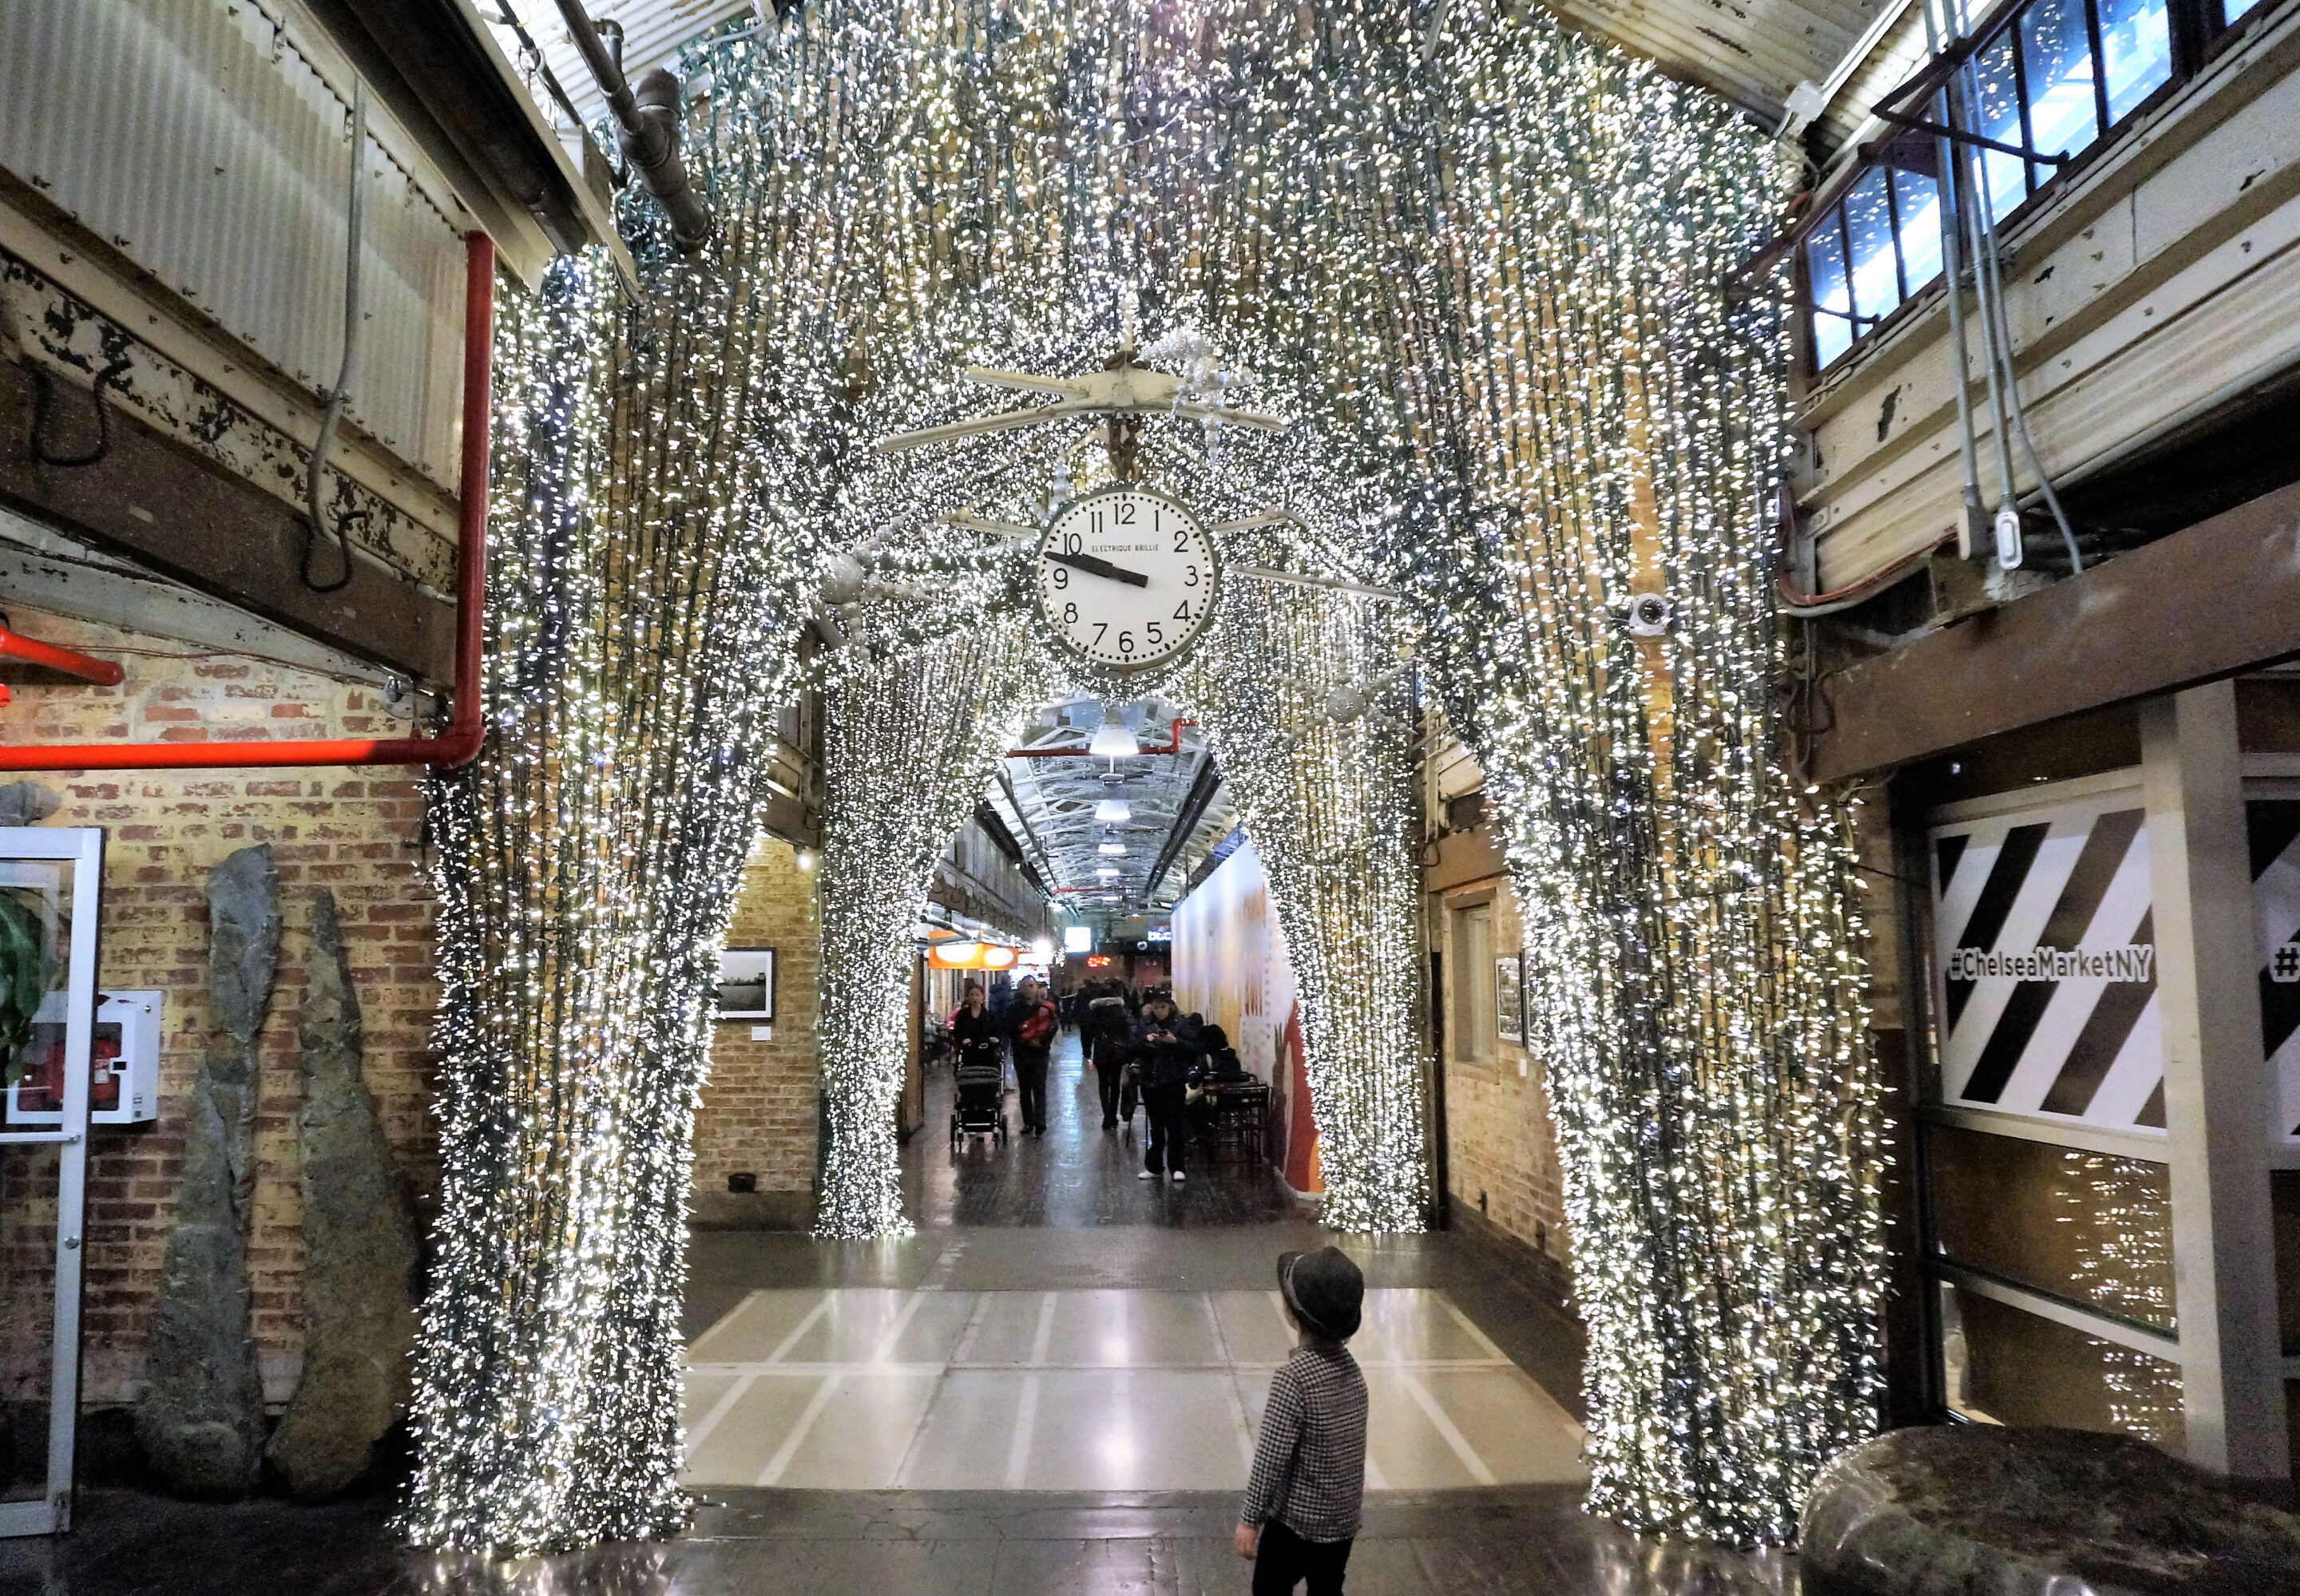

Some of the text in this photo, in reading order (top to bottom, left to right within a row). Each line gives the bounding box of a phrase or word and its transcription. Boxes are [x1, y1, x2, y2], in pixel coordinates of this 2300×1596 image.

[1091, 511, 1103, 533] 11
[1115, 503, 1136, 525] 12
[1155, 509, 1160, 532] 1
[1064, 533, 1082, 556] 10
[1174, 530, 1189, 552] 2
[1053, 568, 1068, 589] 9
[1184, 565, 1199, 587] 3
[1064, 602, 1078, 624] 8
[1172, 600, 1191, 622] 4
[1092, 623, 1108, 645] 7
[1119, 631, 1134, 653] 6
[1147, 622, 1163, 644] 5
[1951, 948, 2151, 979] #ChelseaMarketNY
